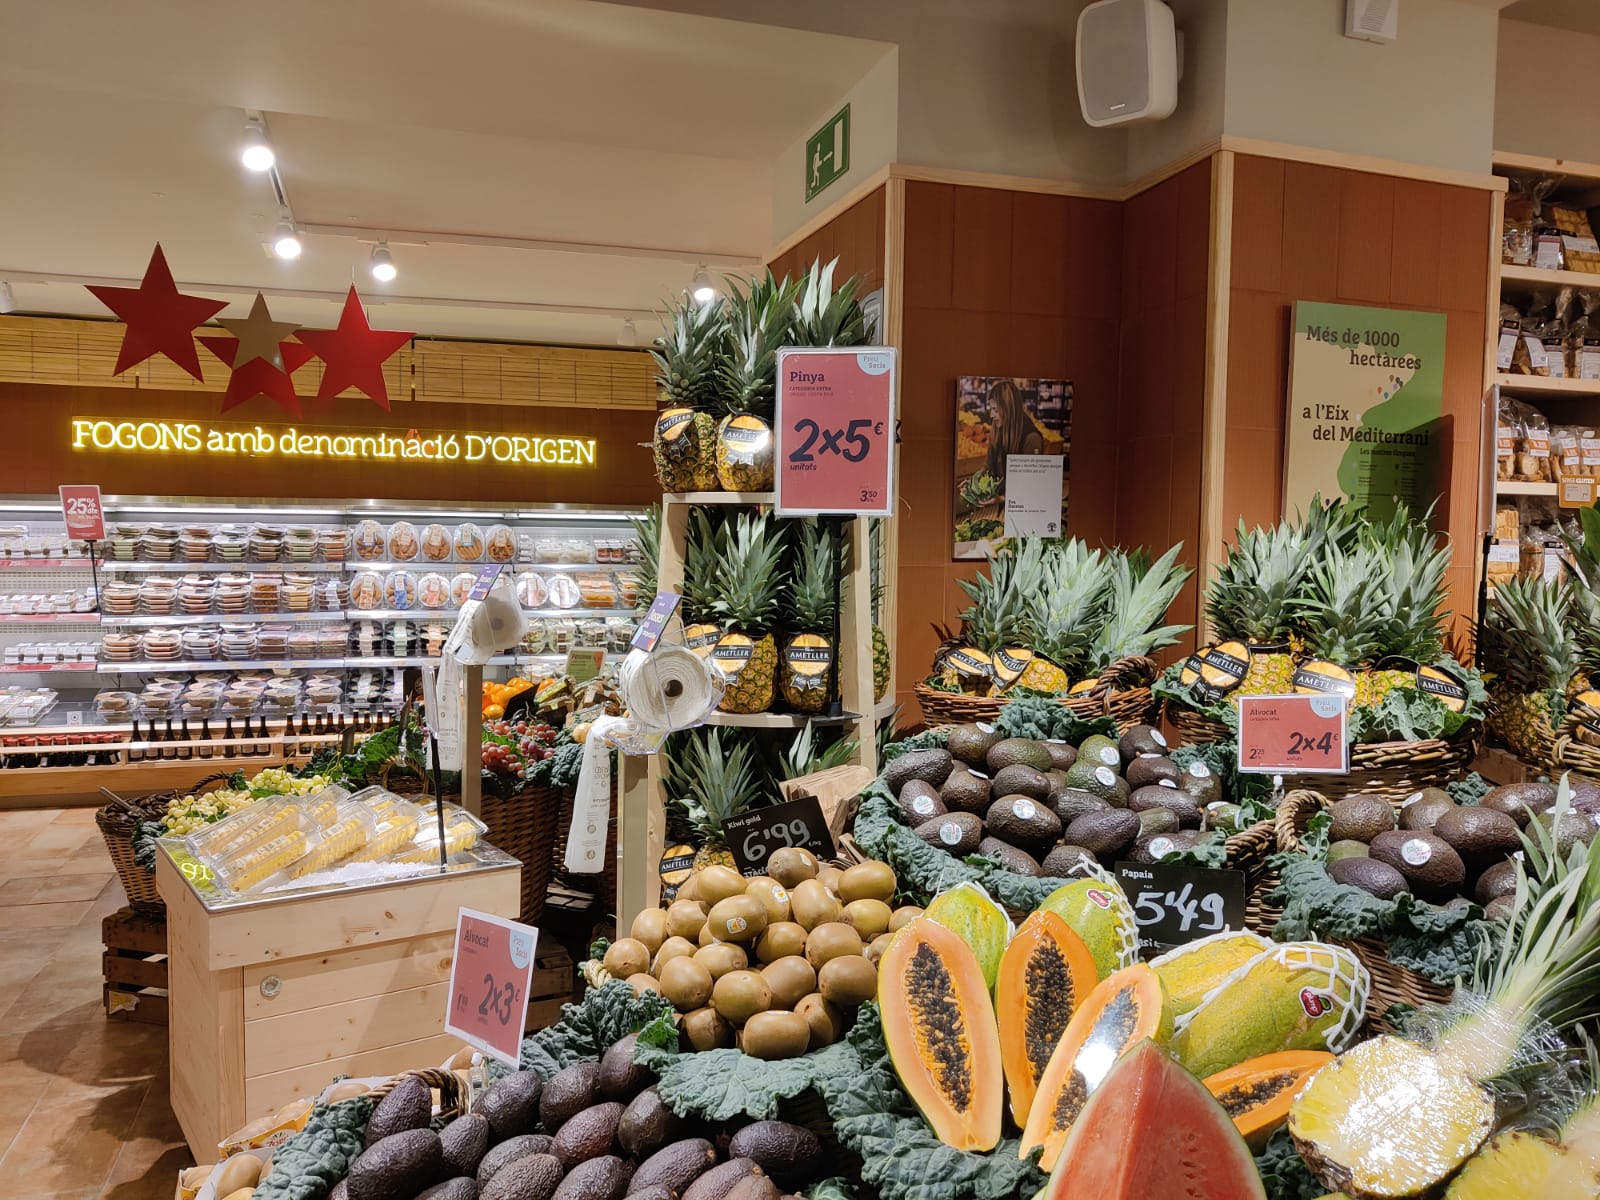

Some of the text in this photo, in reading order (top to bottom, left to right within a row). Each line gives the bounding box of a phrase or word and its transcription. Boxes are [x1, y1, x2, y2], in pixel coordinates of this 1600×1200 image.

[1306, 325, 1400, 348] Més de 1000
[1350, 350, 1422, 370] hectàrees
[789, 370, 825, 385] Pinya
[1302, 404, 1349, 421] a l'Eix
[72, 420, 597, 465] FOGONS amb denominació D'ORIGEN
[1312, 425, 1430, 446] del Mediterrani
[789, 651, 829, 659] AMETLLER
[1207, 654, 1243, 675] AMETLLER
[1121, 868, 1154, 880] Papaia
[463, 930, 489, 949] Alvocat
